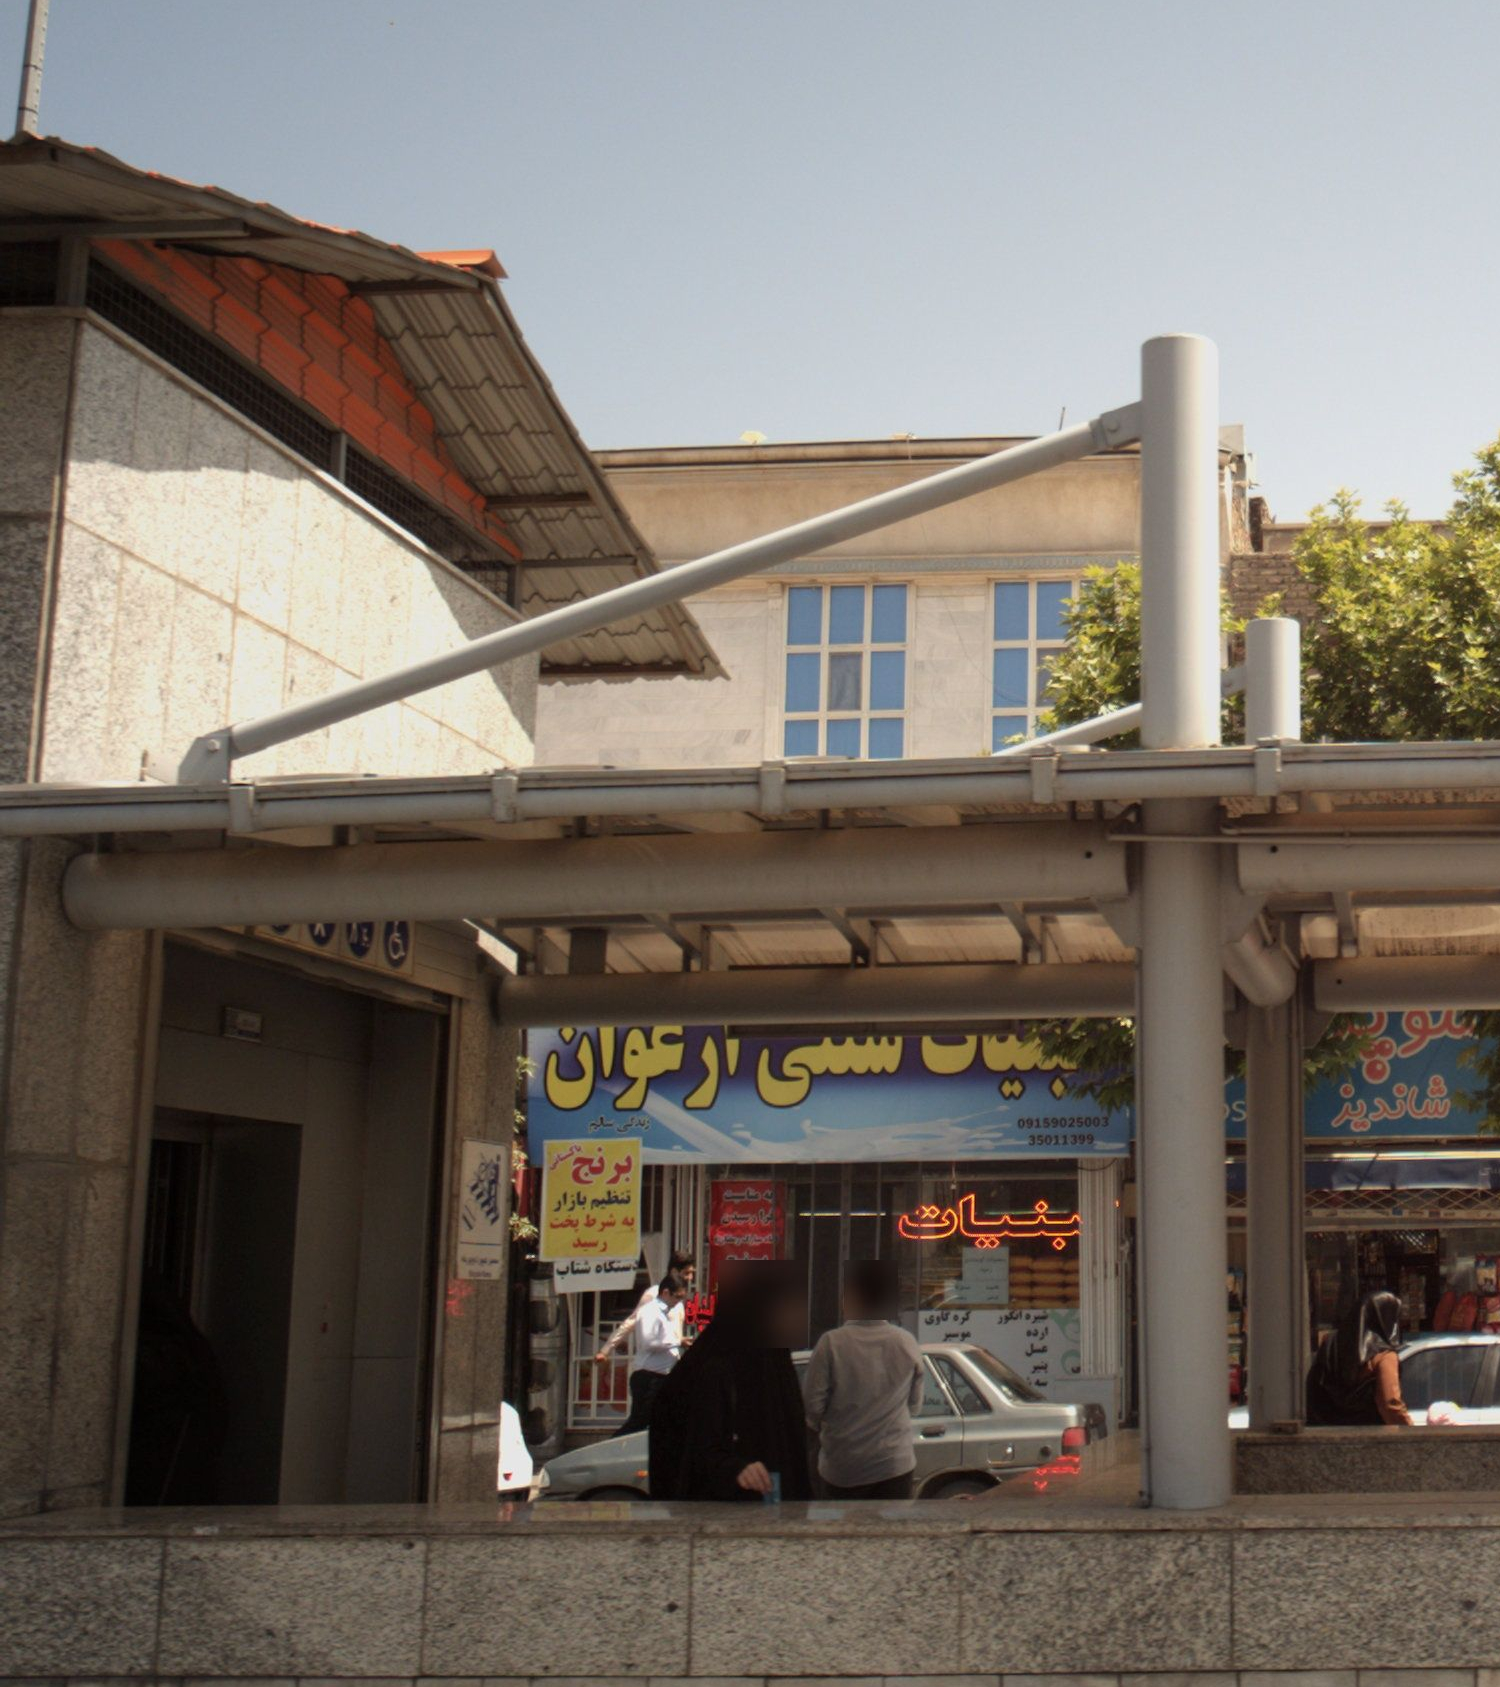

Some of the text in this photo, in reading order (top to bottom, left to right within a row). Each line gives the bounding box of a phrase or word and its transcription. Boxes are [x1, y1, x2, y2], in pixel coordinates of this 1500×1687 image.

[1331, 1075, 1450, 1132] شاندیز
[1017, 1115, 1110, 1129] 09159025003
[1028, 1133, 1095, 1146] 35011399
[553, 1189, 631, 1212] تنظیم بازار
